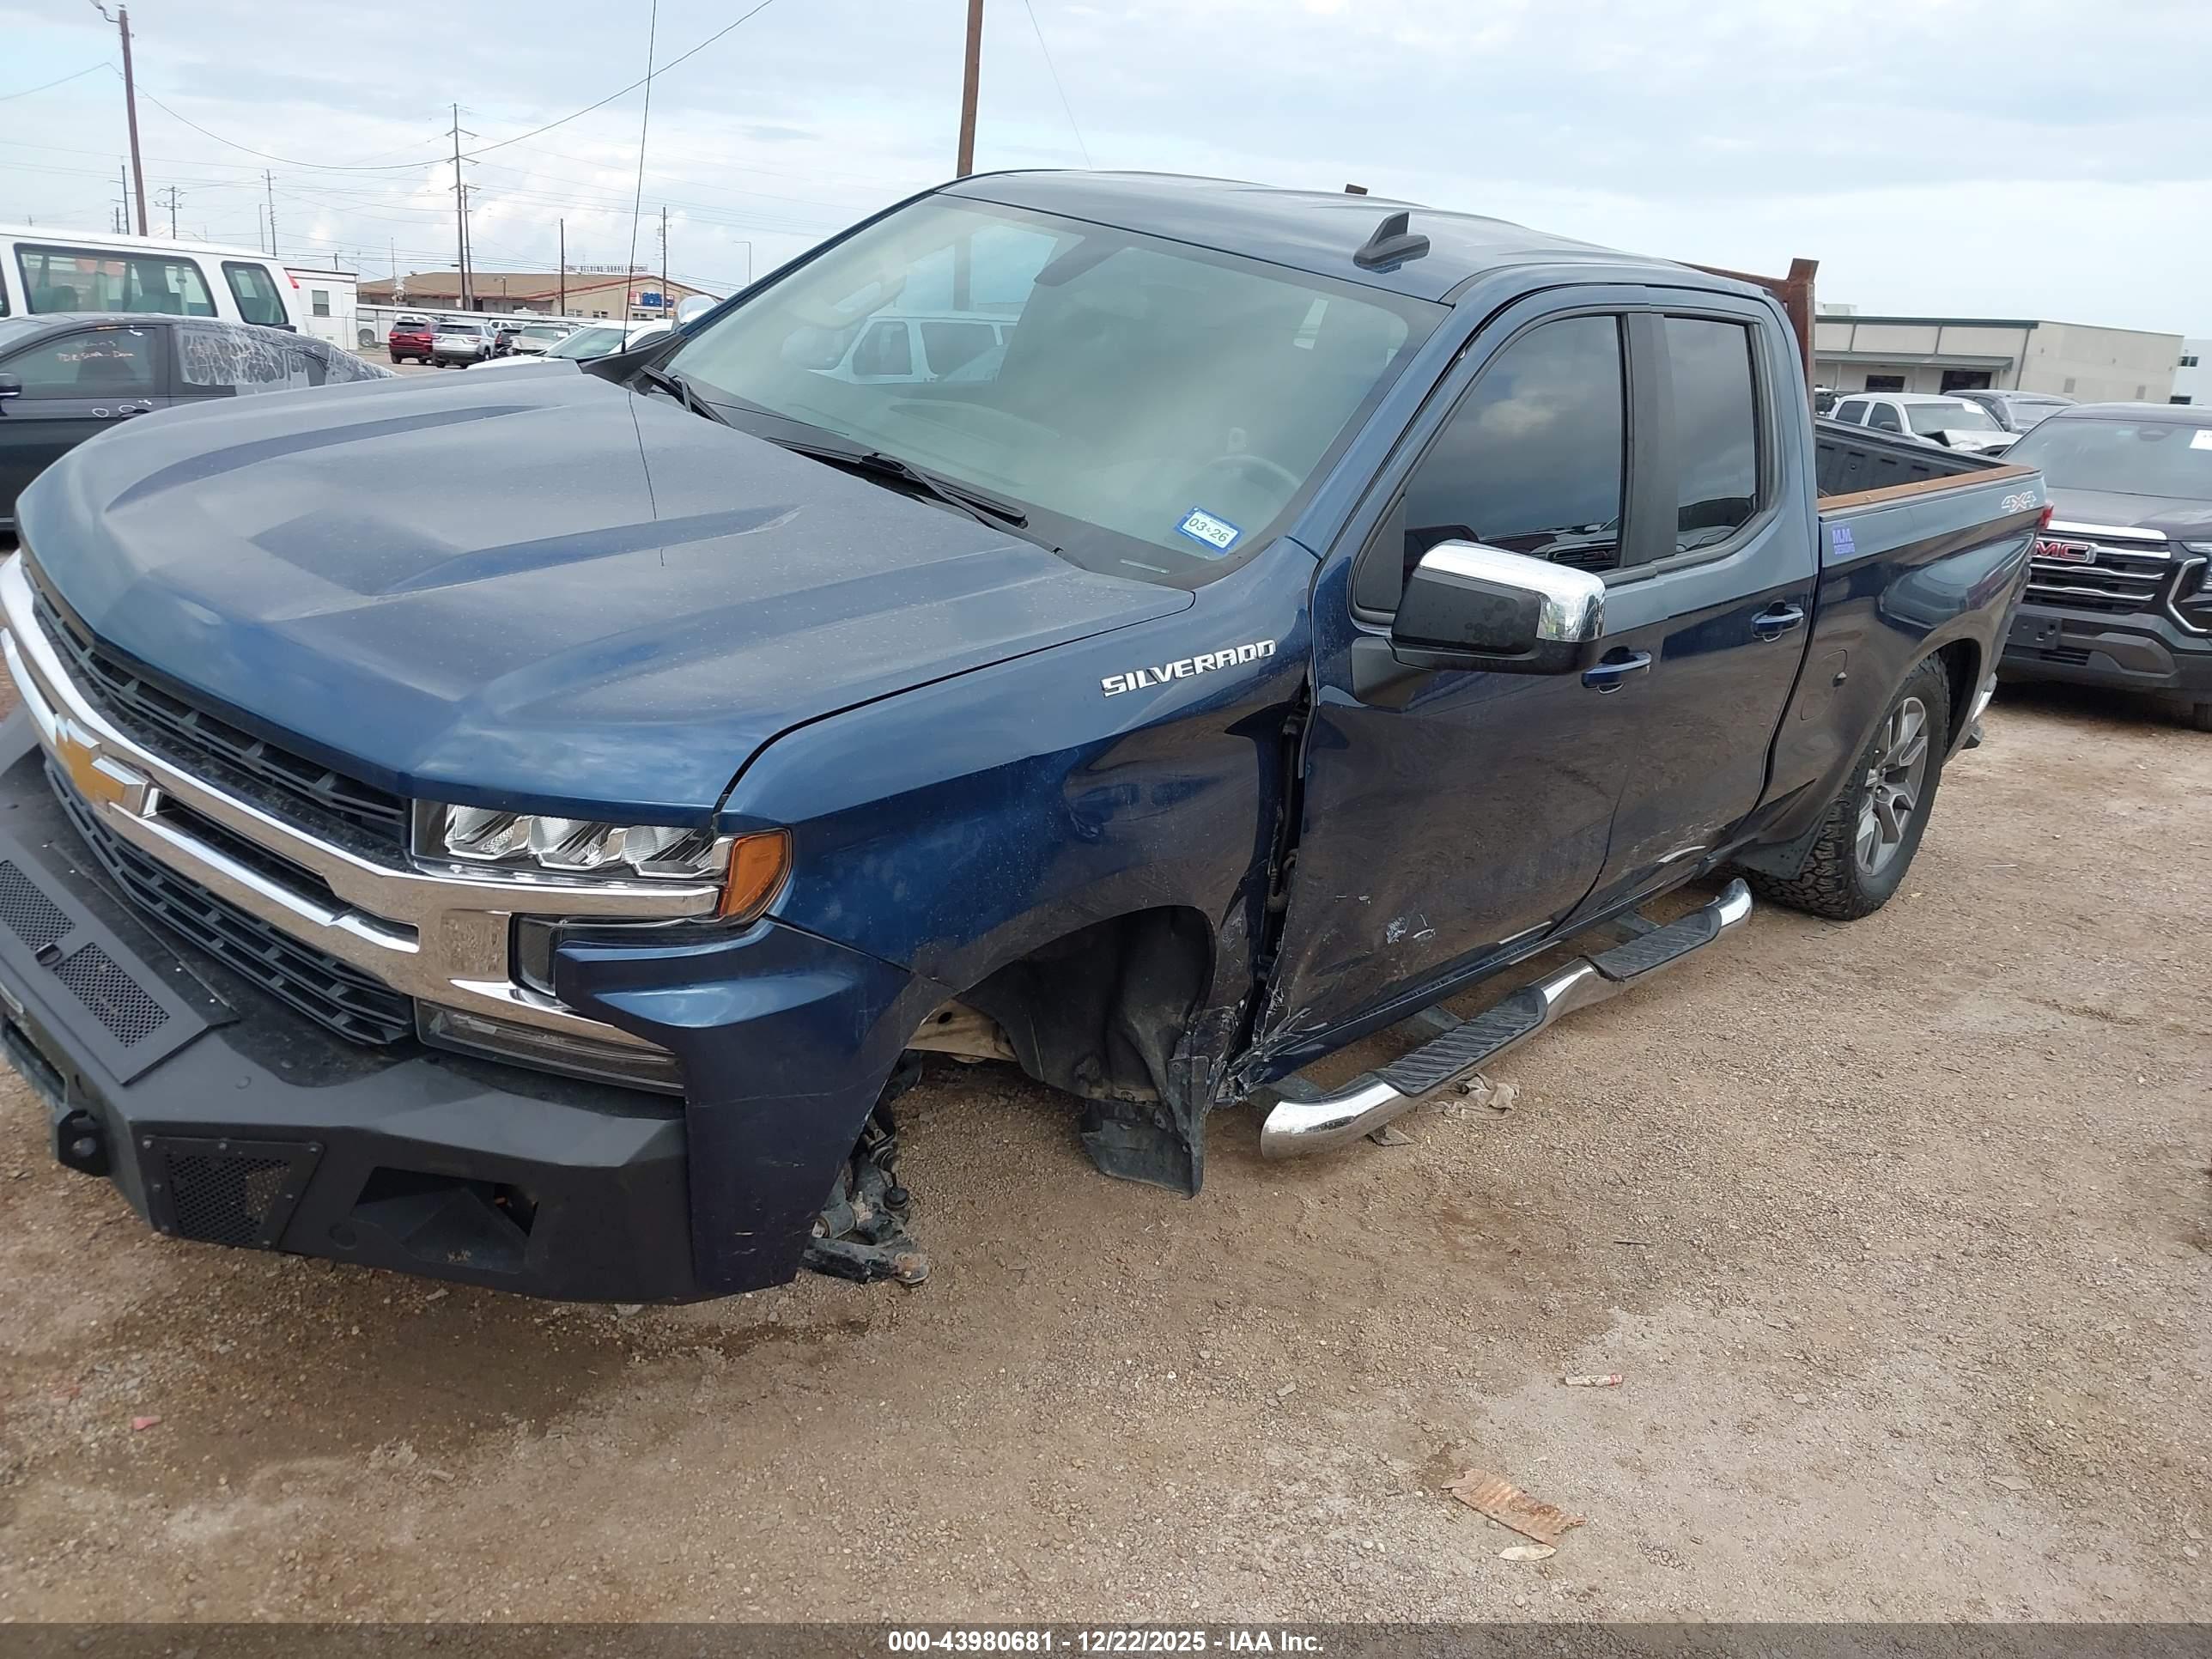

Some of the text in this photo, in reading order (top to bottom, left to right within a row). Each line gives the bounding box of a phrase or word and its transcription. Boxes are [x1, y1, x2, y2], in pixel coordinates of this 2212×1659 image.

[1188, 518, 1207, 531] 03
[1209, 529, 1229, 542] 26
[2033, 540, 2090, 561] MC
[1100, 639, 1277, 698] SILVERADO
